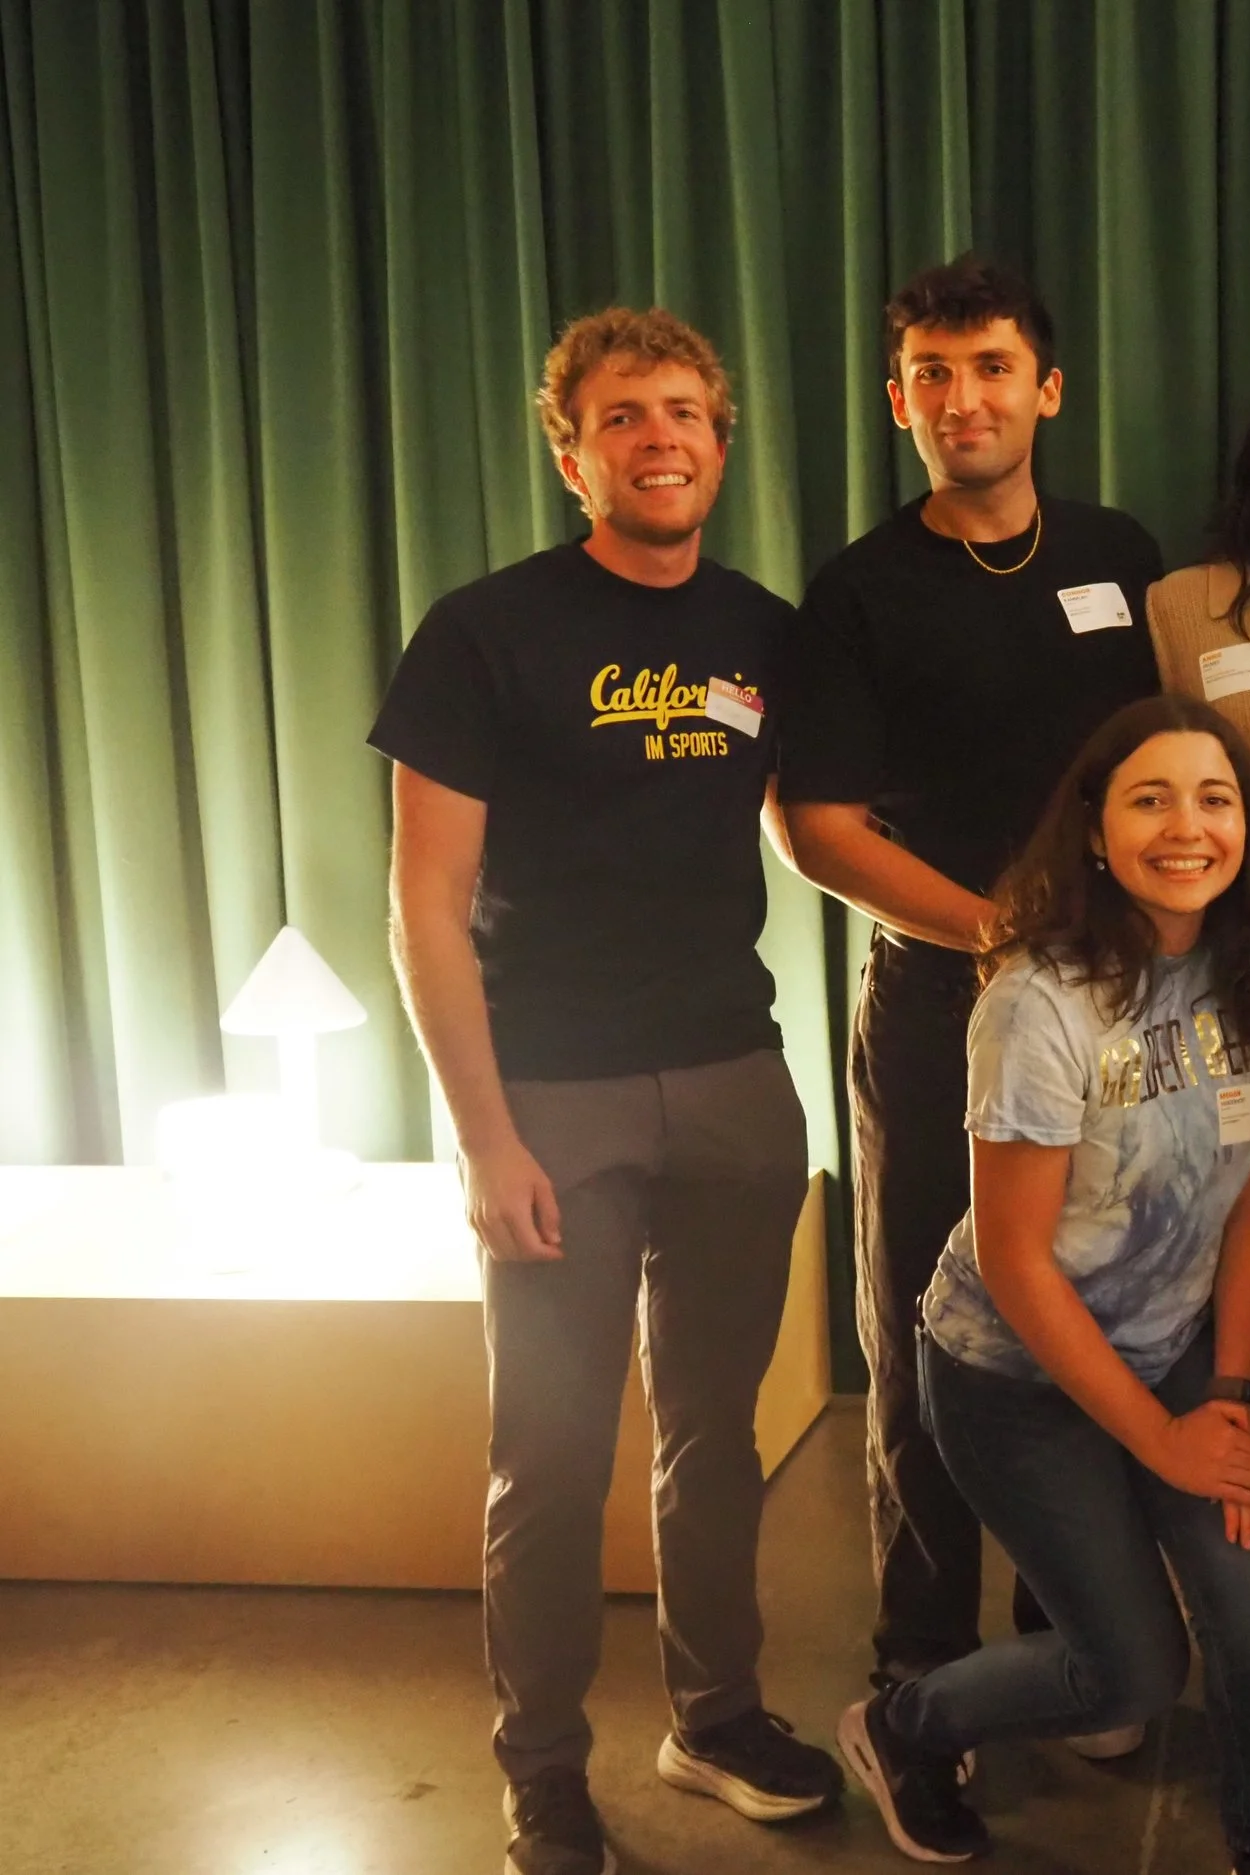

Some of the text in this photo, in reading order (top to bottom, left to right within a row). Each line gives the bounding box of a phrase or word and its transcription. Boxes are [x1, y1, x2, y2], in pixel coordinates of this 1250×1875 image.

[590, 663, 758, 730] Califor
[721, 683, 752, 703] HELLO
[645, 732, 729, 760] IM SPORTS
